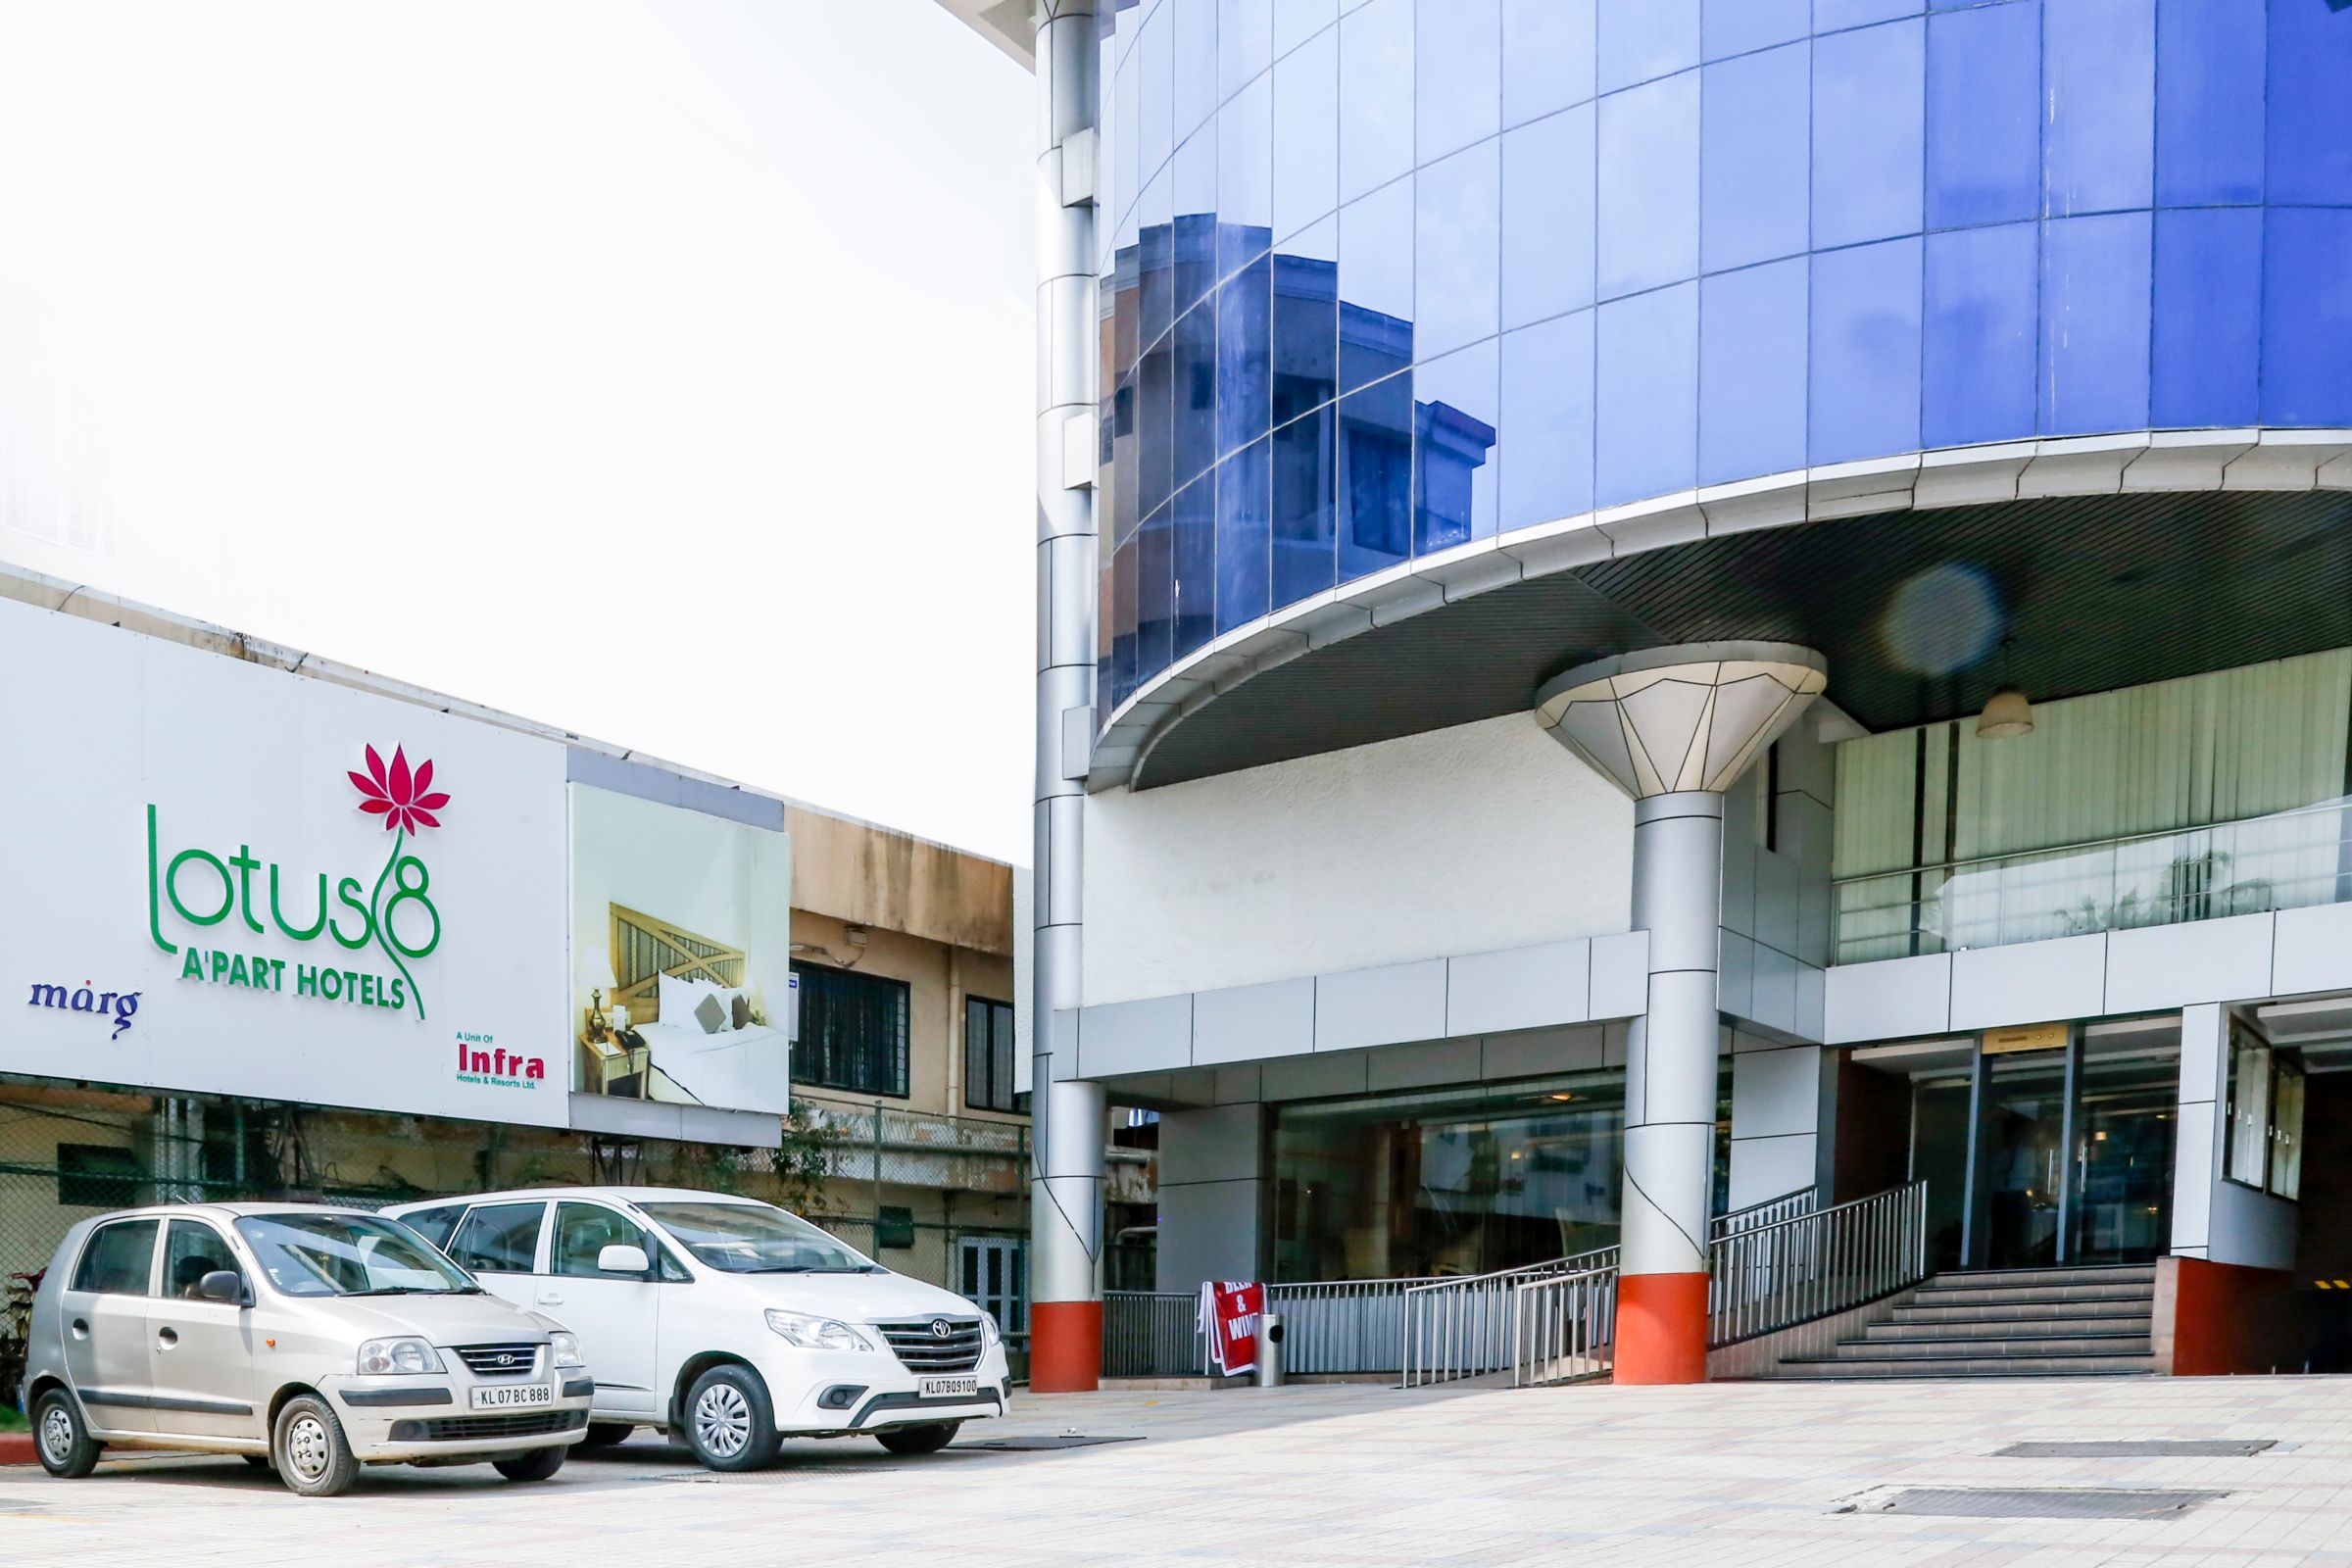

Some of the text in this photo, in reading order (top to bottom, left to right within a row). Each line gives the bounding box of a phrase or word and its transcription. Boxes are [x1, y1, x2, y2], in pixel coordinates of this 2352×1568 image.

[297, 964, 405, 1010] HOTELS
[456, 1031, 493, 1044] A Unit Of
[459, 1043, 544, 1079] Infra
[457, 1073, 481, 1085] Hotels
[483, 1076, 489, 1085] &
[491, 1077, 520, 1089] Resorts
[1237, 1294, 1247, 1313] &
[1228, 1312, 1259, 1342] WIN
